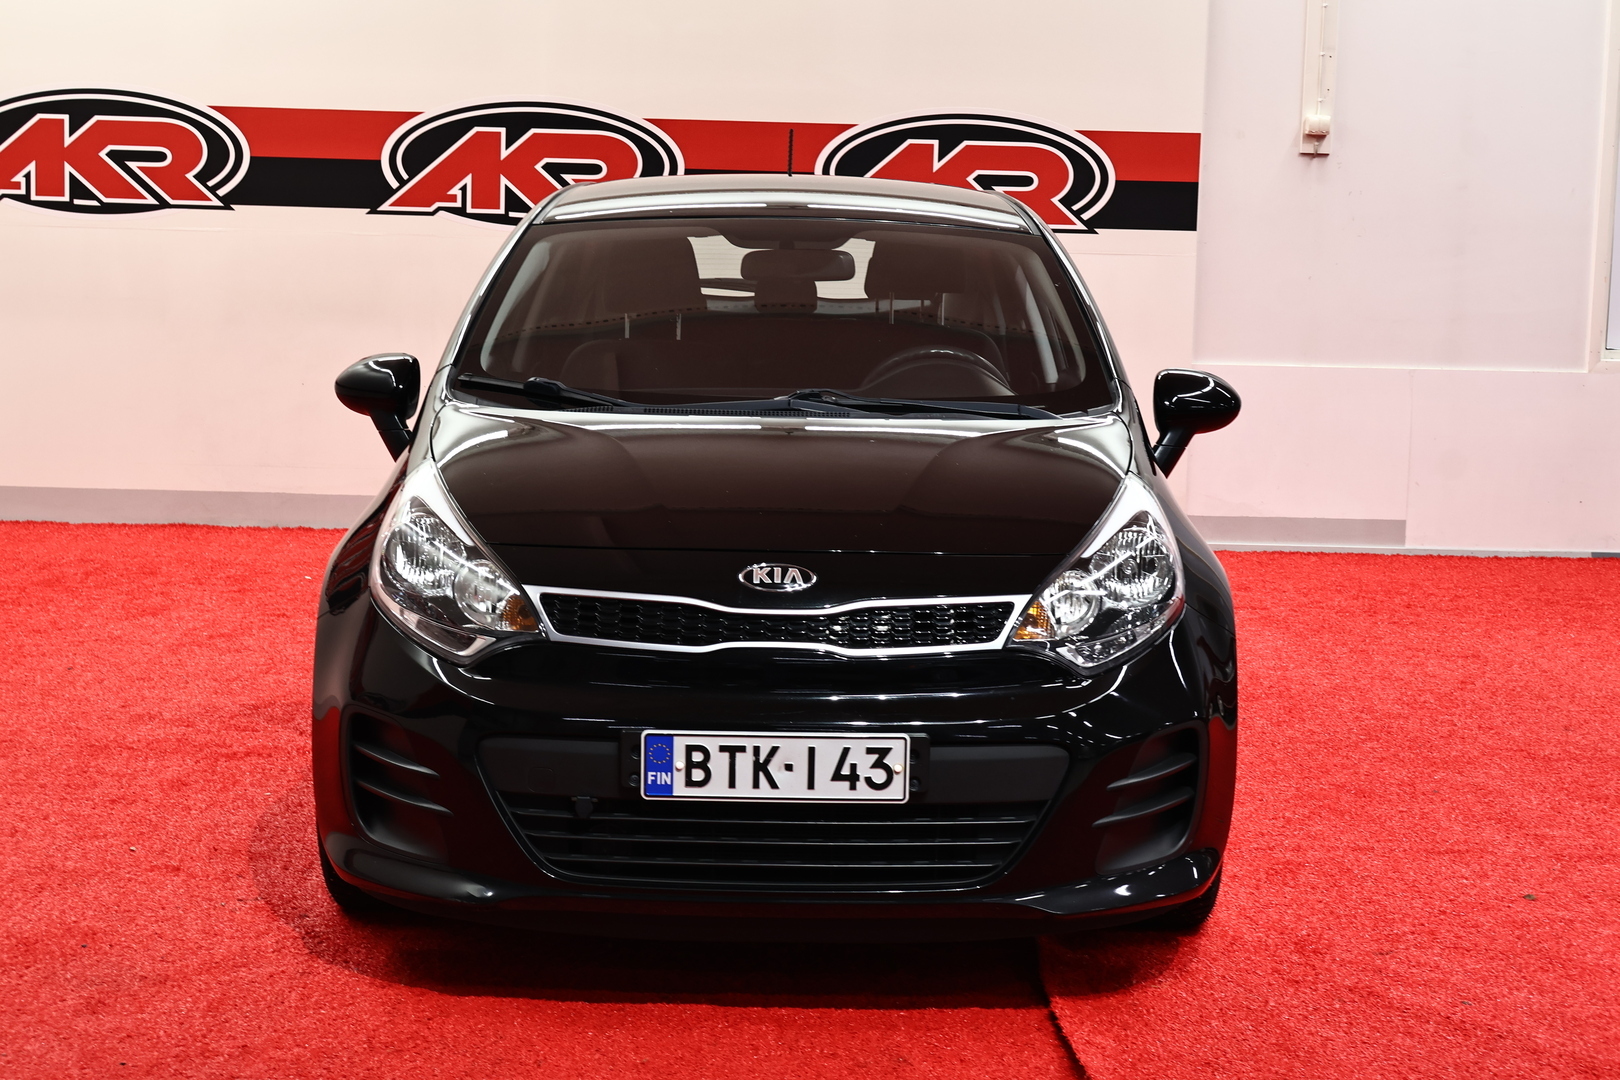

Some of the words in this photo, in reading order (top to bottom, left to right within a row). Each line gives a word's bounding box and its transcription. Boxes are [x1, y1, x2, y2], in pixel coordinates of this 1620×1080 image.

[0, 113, 227, 205] AKR
[752, 567, 804, 584] KIA
[647, 772, 672, 785] FIN
